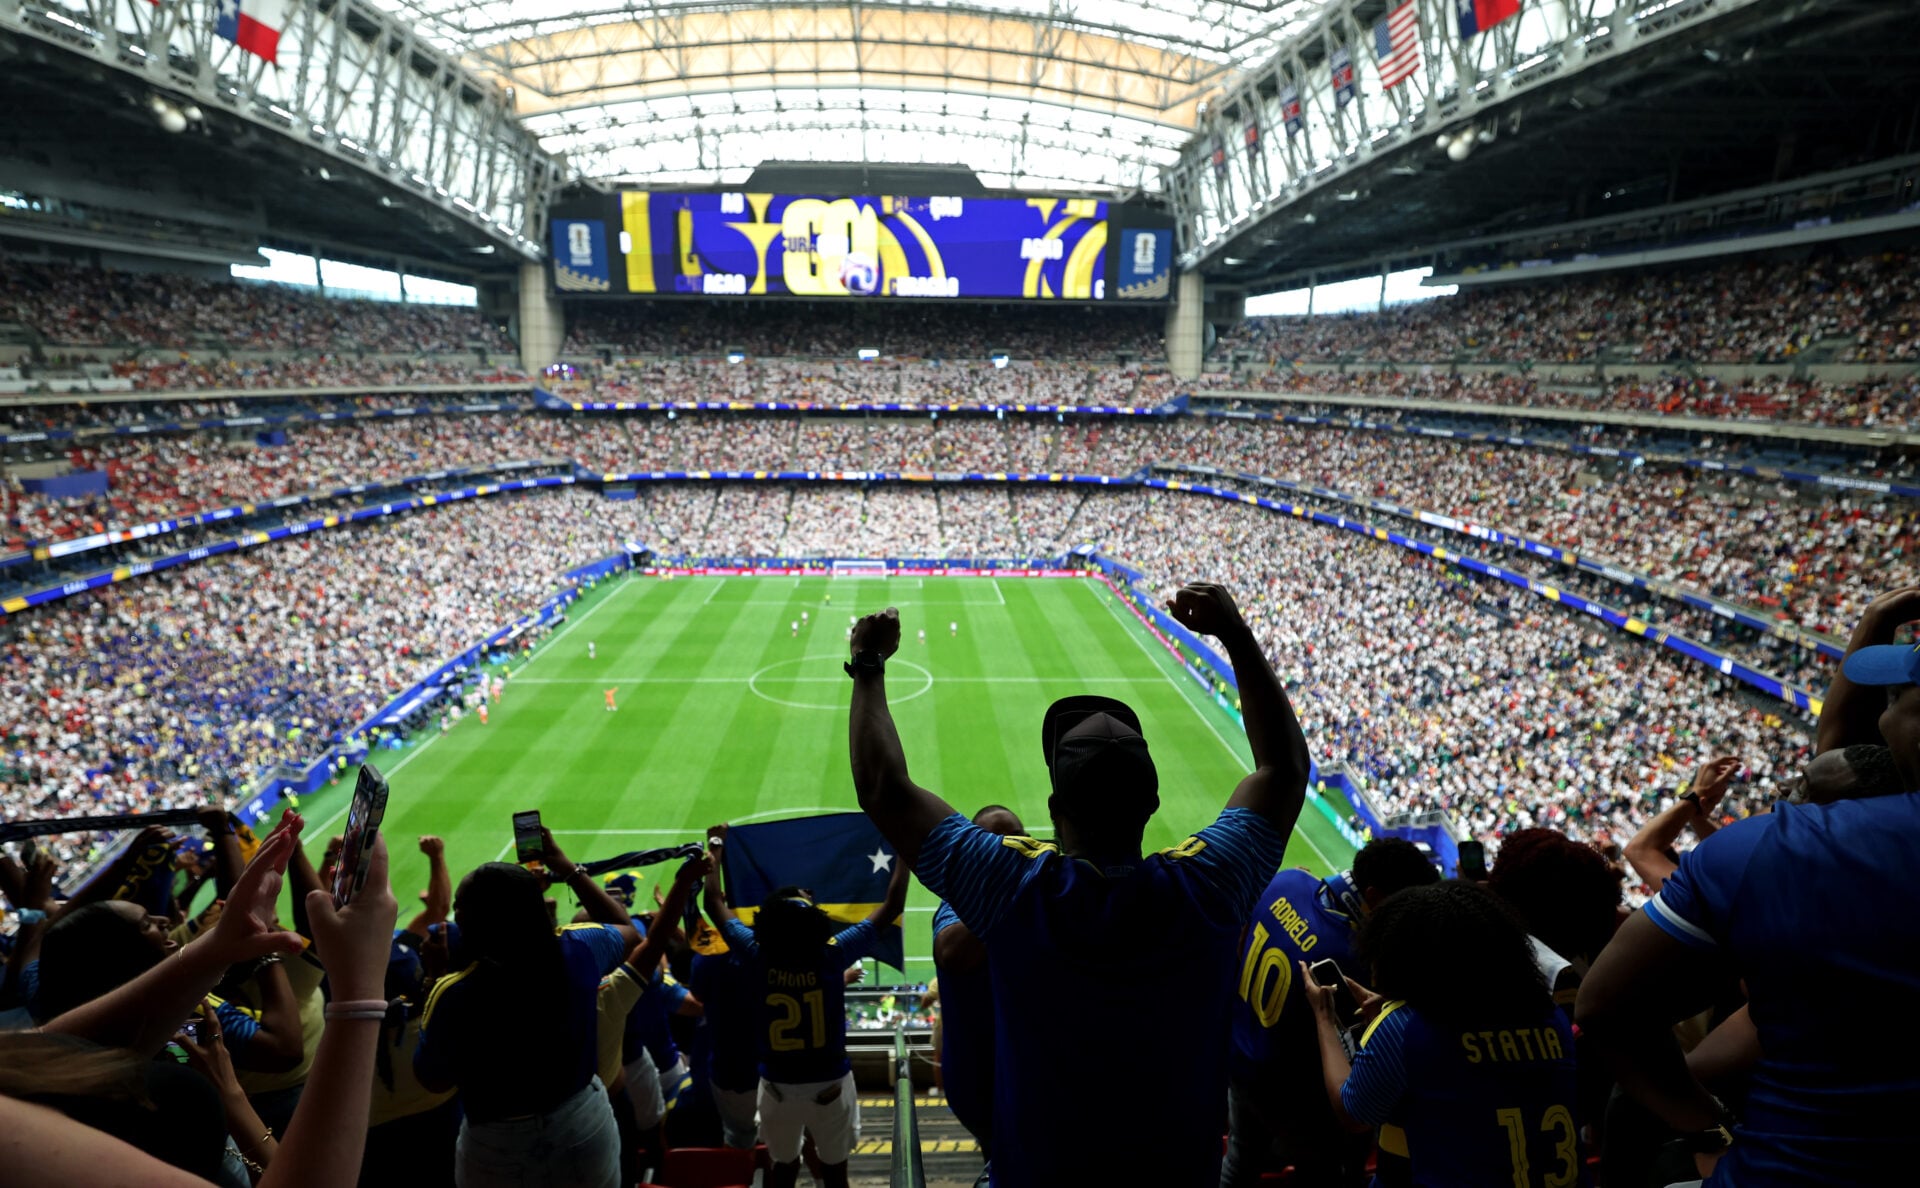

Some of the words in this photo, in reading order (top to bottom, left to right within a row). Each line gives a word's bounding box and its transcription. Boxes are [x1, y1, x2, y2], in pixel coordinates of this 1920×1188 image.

[767, 968, 817, 988] CHONG
[1238, 921, 1292, 1028] 10
[766, 990, 826, 1051] 21
[1461, 1026, 1564, 1064] STATIA
[1496, 1104, 1579, 1188] 13
